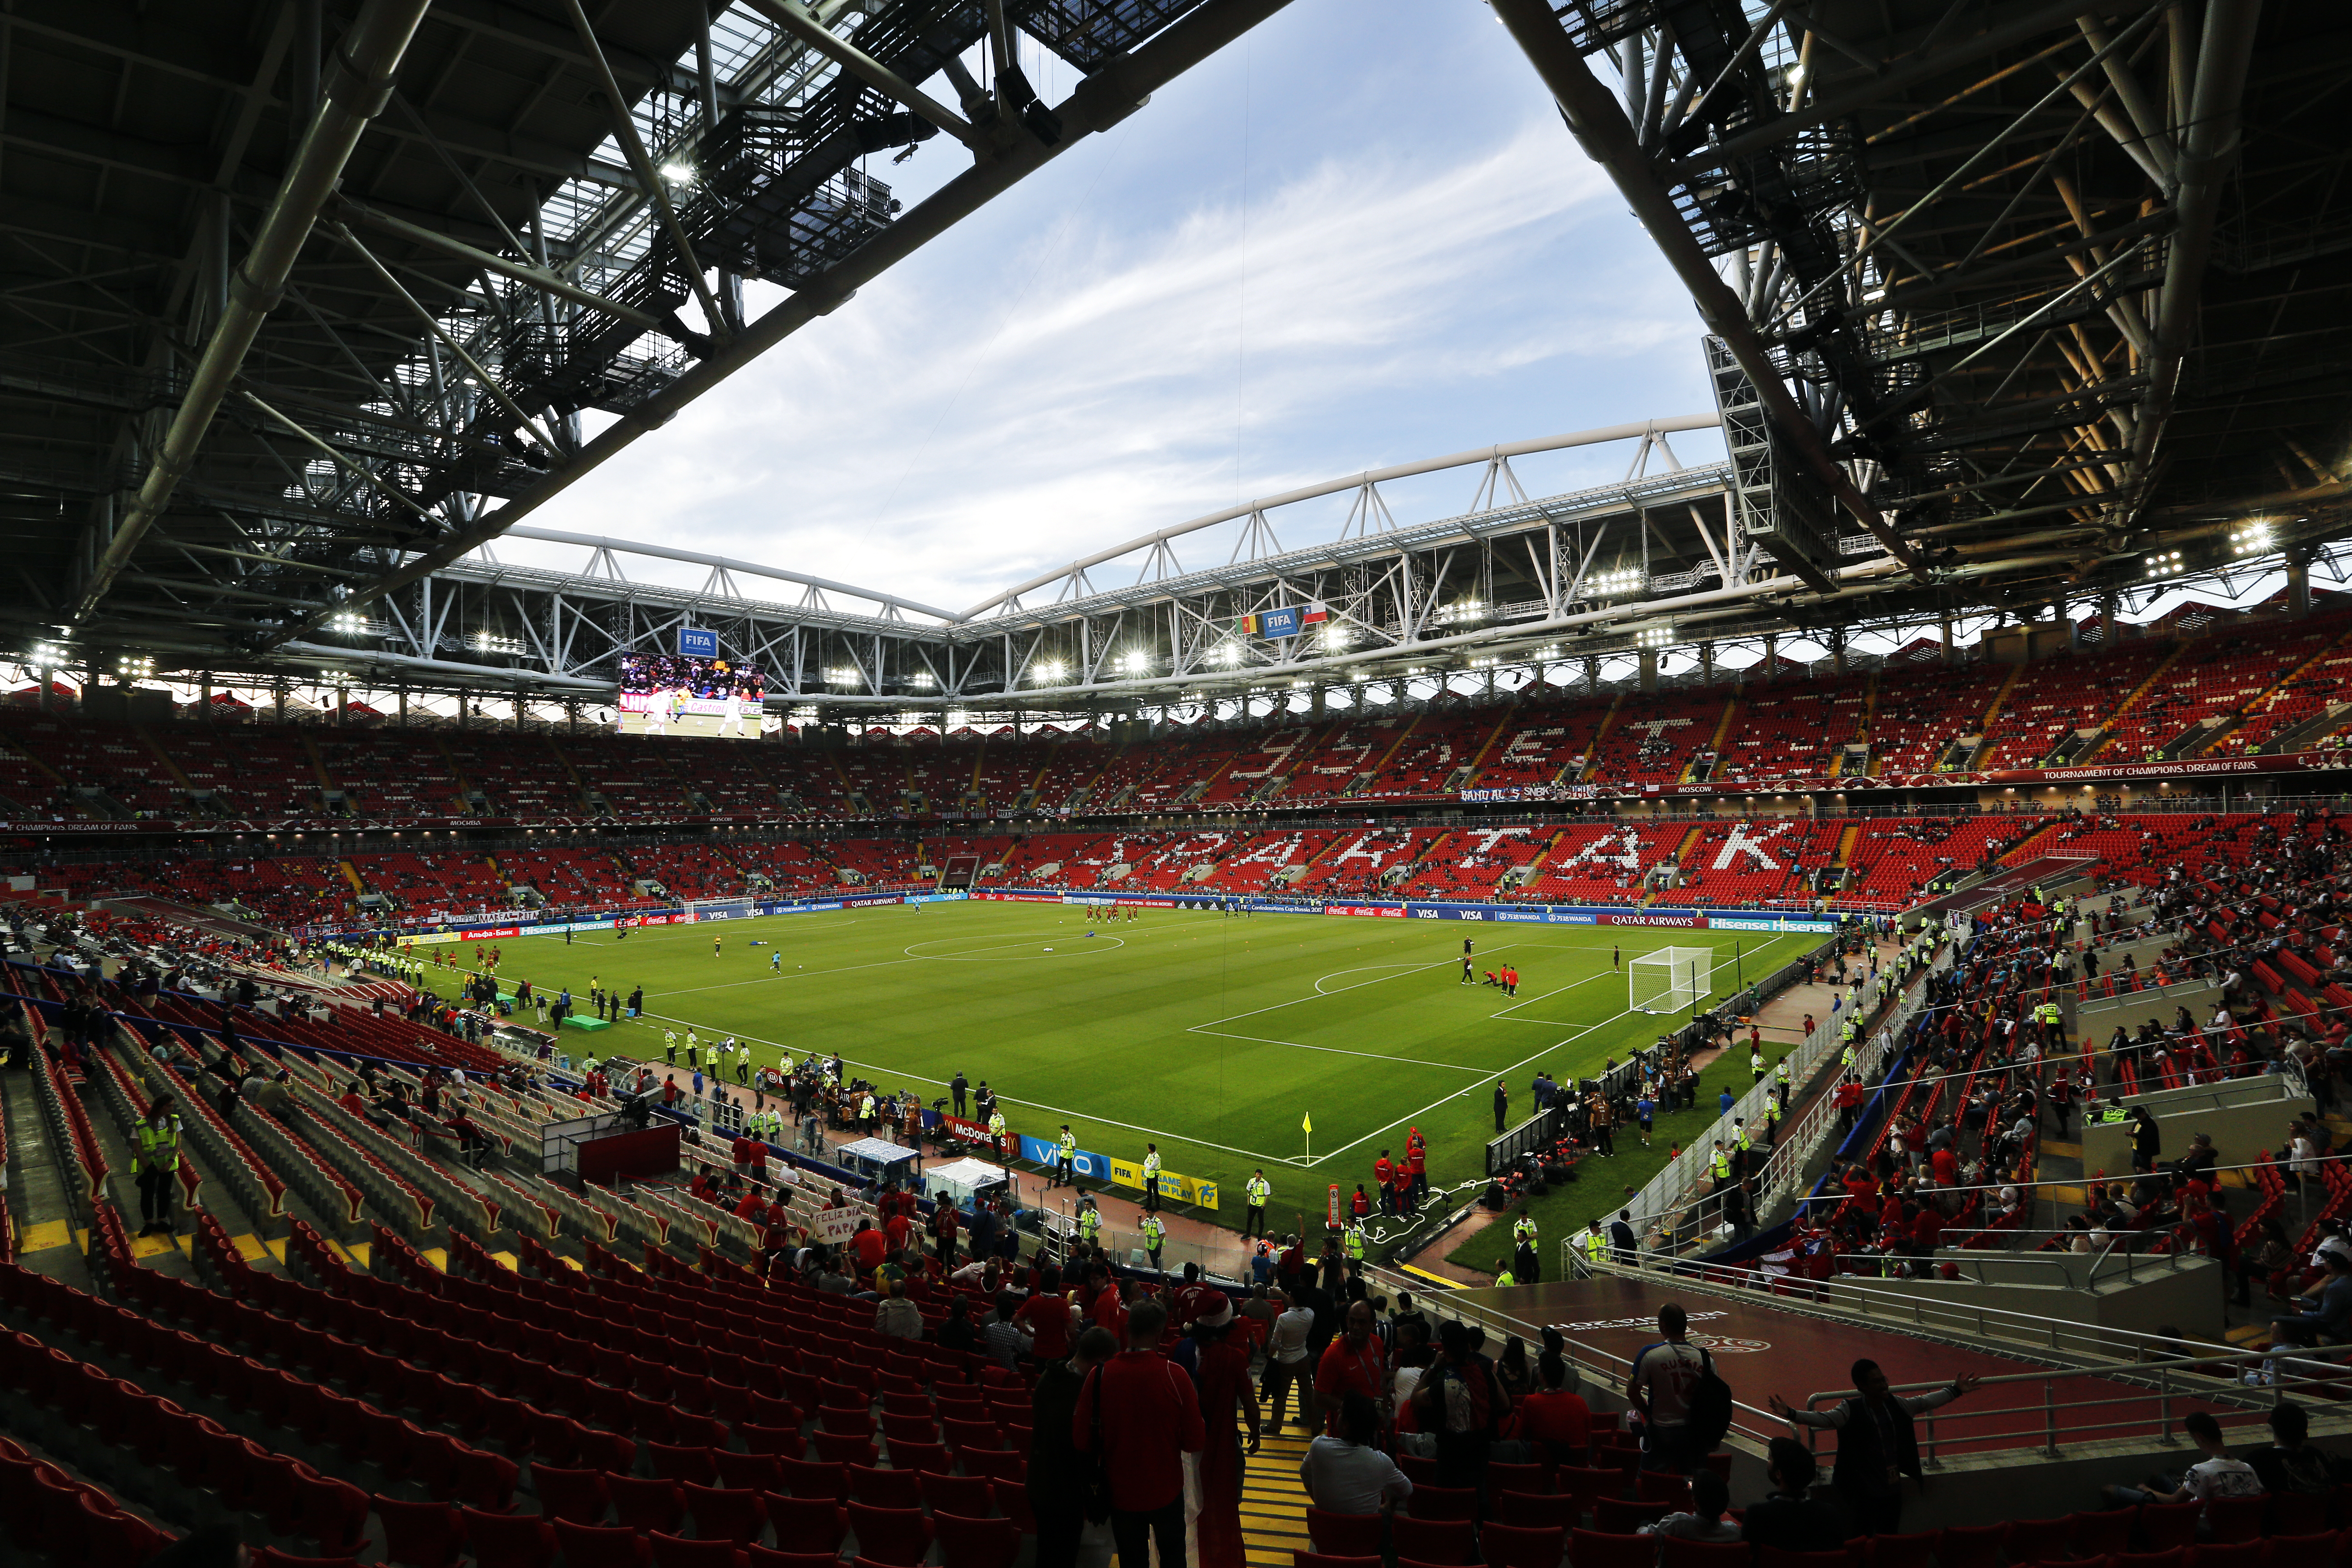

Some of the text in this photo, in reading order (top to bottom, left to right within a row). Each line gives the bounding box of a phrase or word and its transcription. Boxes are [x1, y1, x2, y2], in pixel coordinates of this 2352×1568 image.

[1267, 614, 1291, 628] FIFA
[686, 635, 711, 647] FIFA
[691, 701, 725, 713] Castrol
[2043, 760, 2258, 779] TOURNAMENT OF CHAMPIONS. DREAM OF FANS.
[708, 911, 728, 920] VISA
[1328, 906, 1402, 917] Coca-Cola Coca-Cola Coca-Cola
[1416, 909, 1483, 920] VISA VISA
[480, 913, 507, 924] MAREA
[647, 916, 667, 925] Coca-Cola
[675, 914, 695, 922] Coca-Cola
[1612, 916, 1694, 927] QATAR AIRWAYS
[521, 921, 612, 936] Hisense Hisense
[1711, 918, 1832, 933] Hisense Hisense
[1114, 1167, 1132, 1179] FIFA
[1171, 1186, 1192, 1200] PLAY
[1660, 1358, 1704, 1373] RUSSIA
